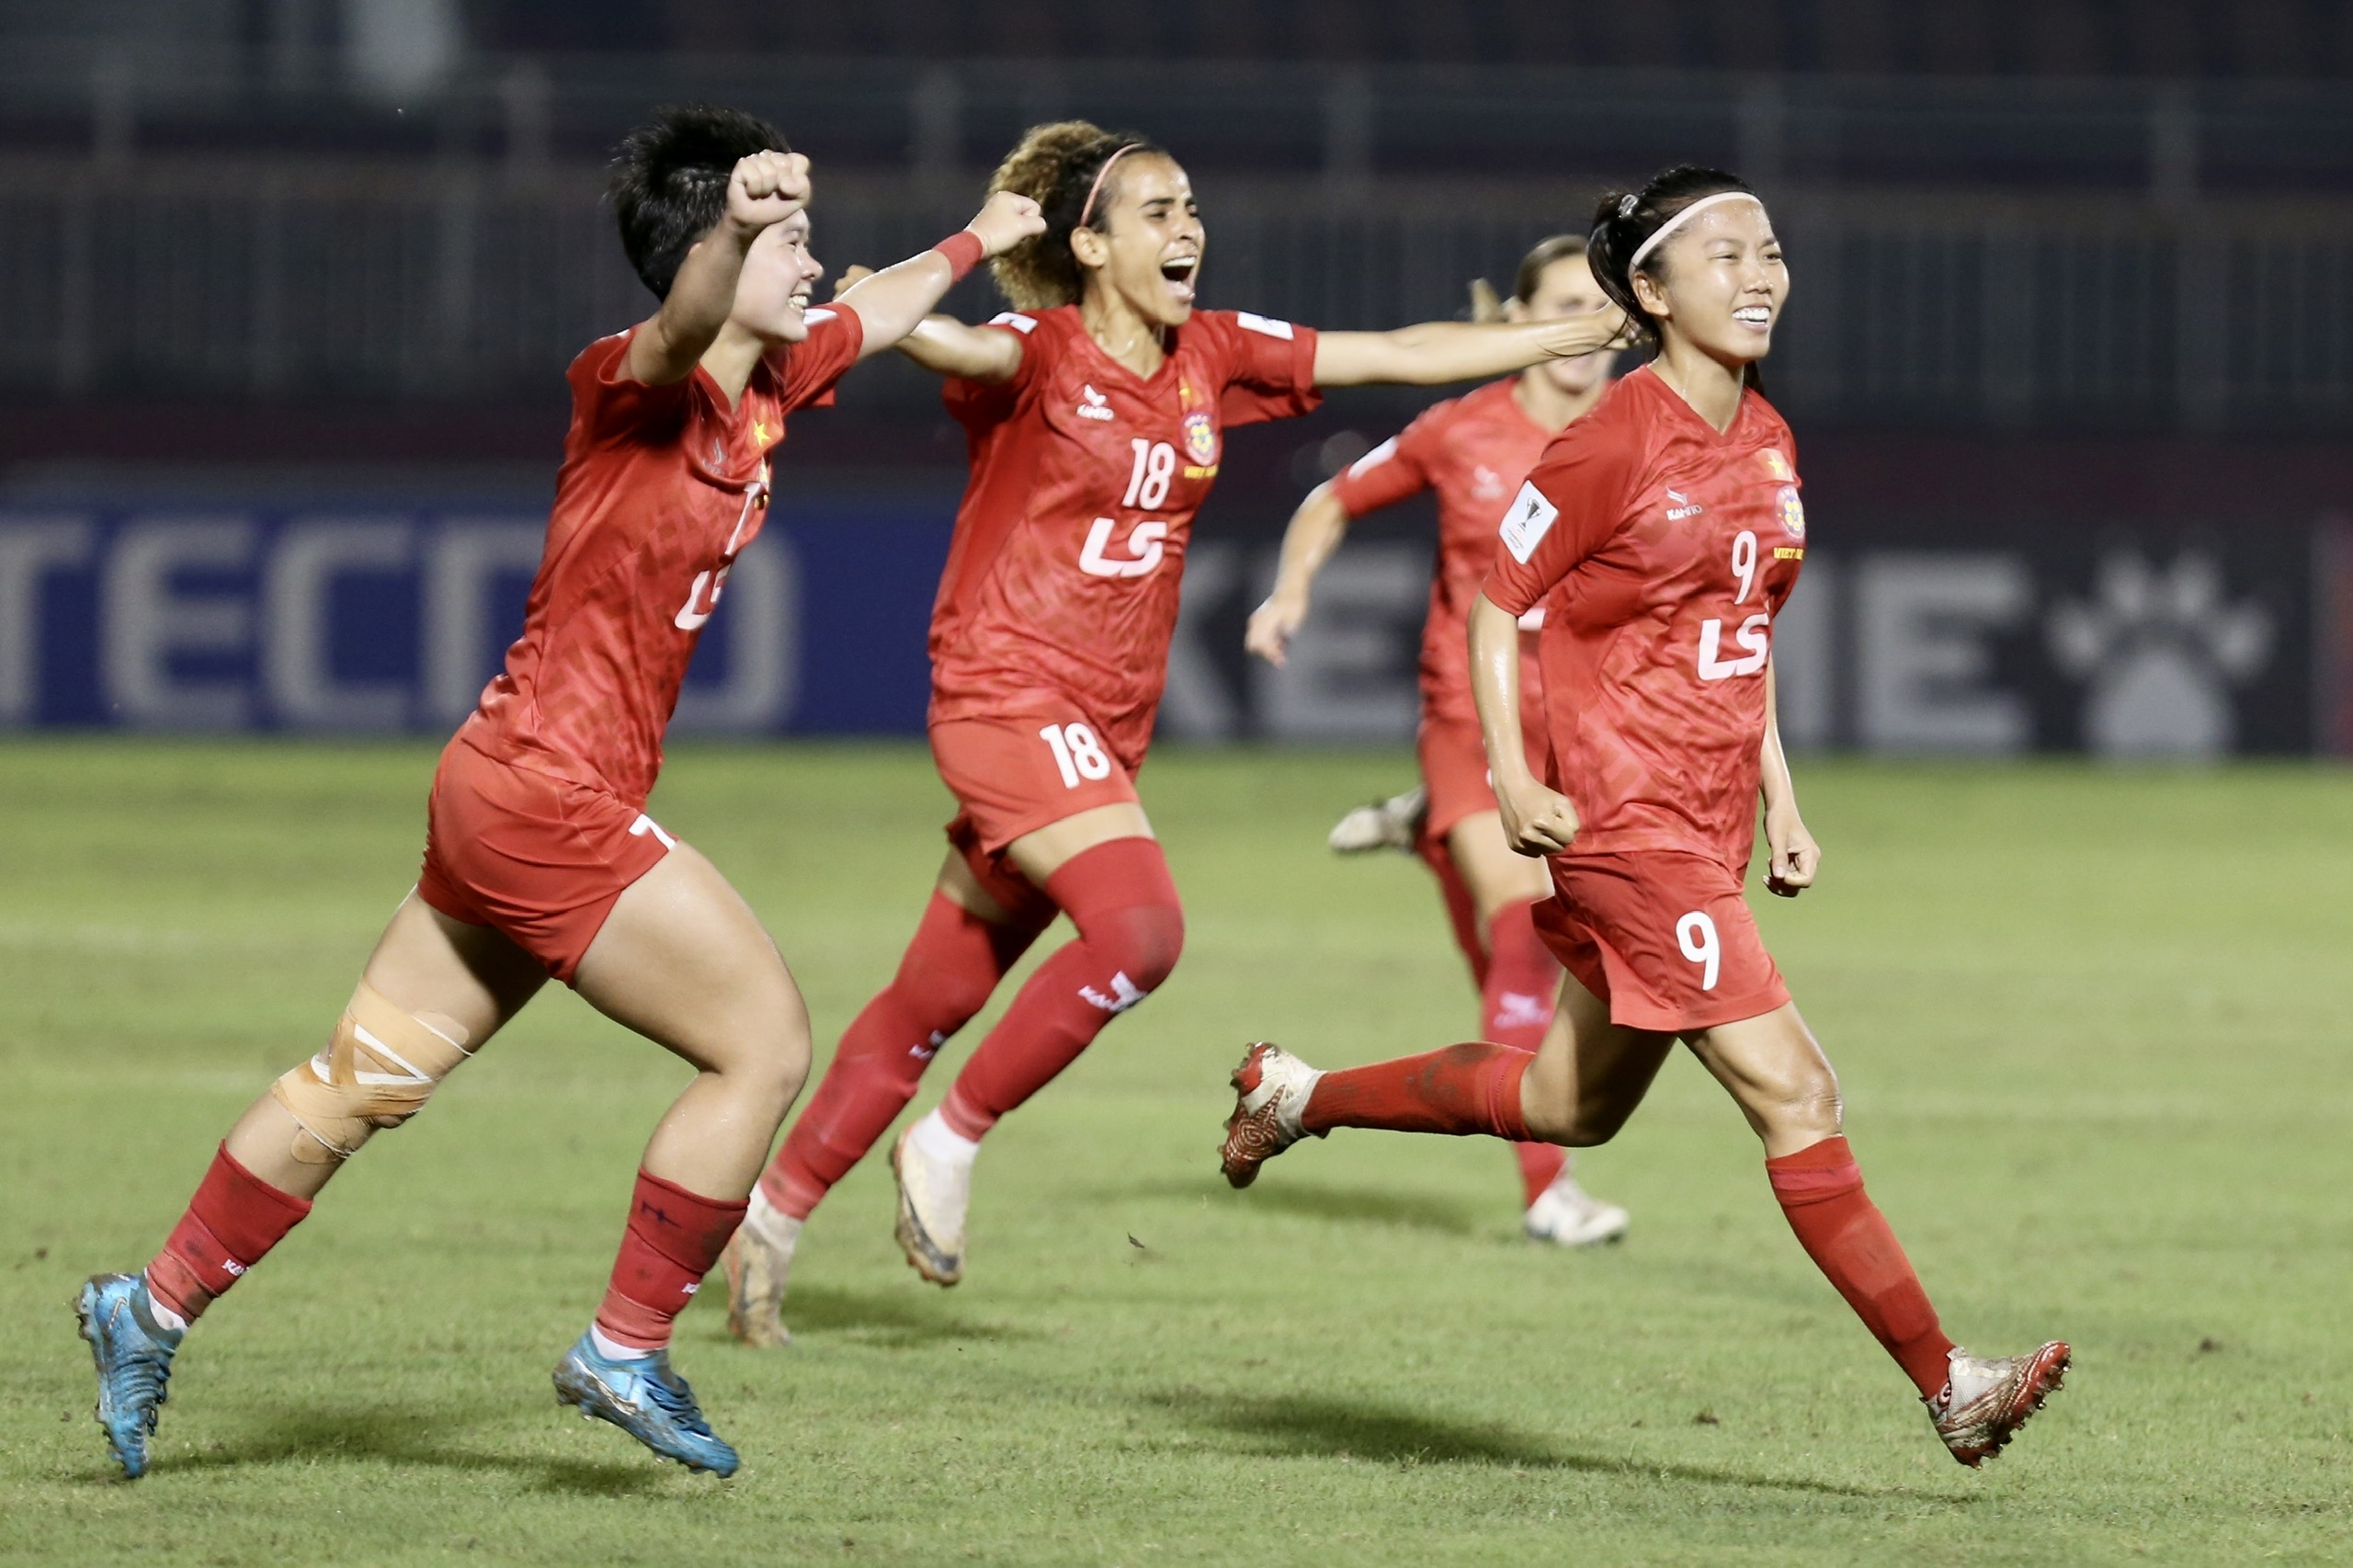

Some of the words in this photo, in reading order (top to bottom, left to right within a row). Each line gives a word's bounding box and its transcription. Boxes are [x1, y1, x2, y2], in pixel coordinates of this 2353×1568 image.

[1122, 438, 1176, 510] 18
[1079, 517, 1167, 577] LS
[1731, 529, 1757, 605] 9
[1697, 613, 1769, 680] LS
[1039, 722, 1111, 790] 18
[1676, 910, 1720, 991] 9
